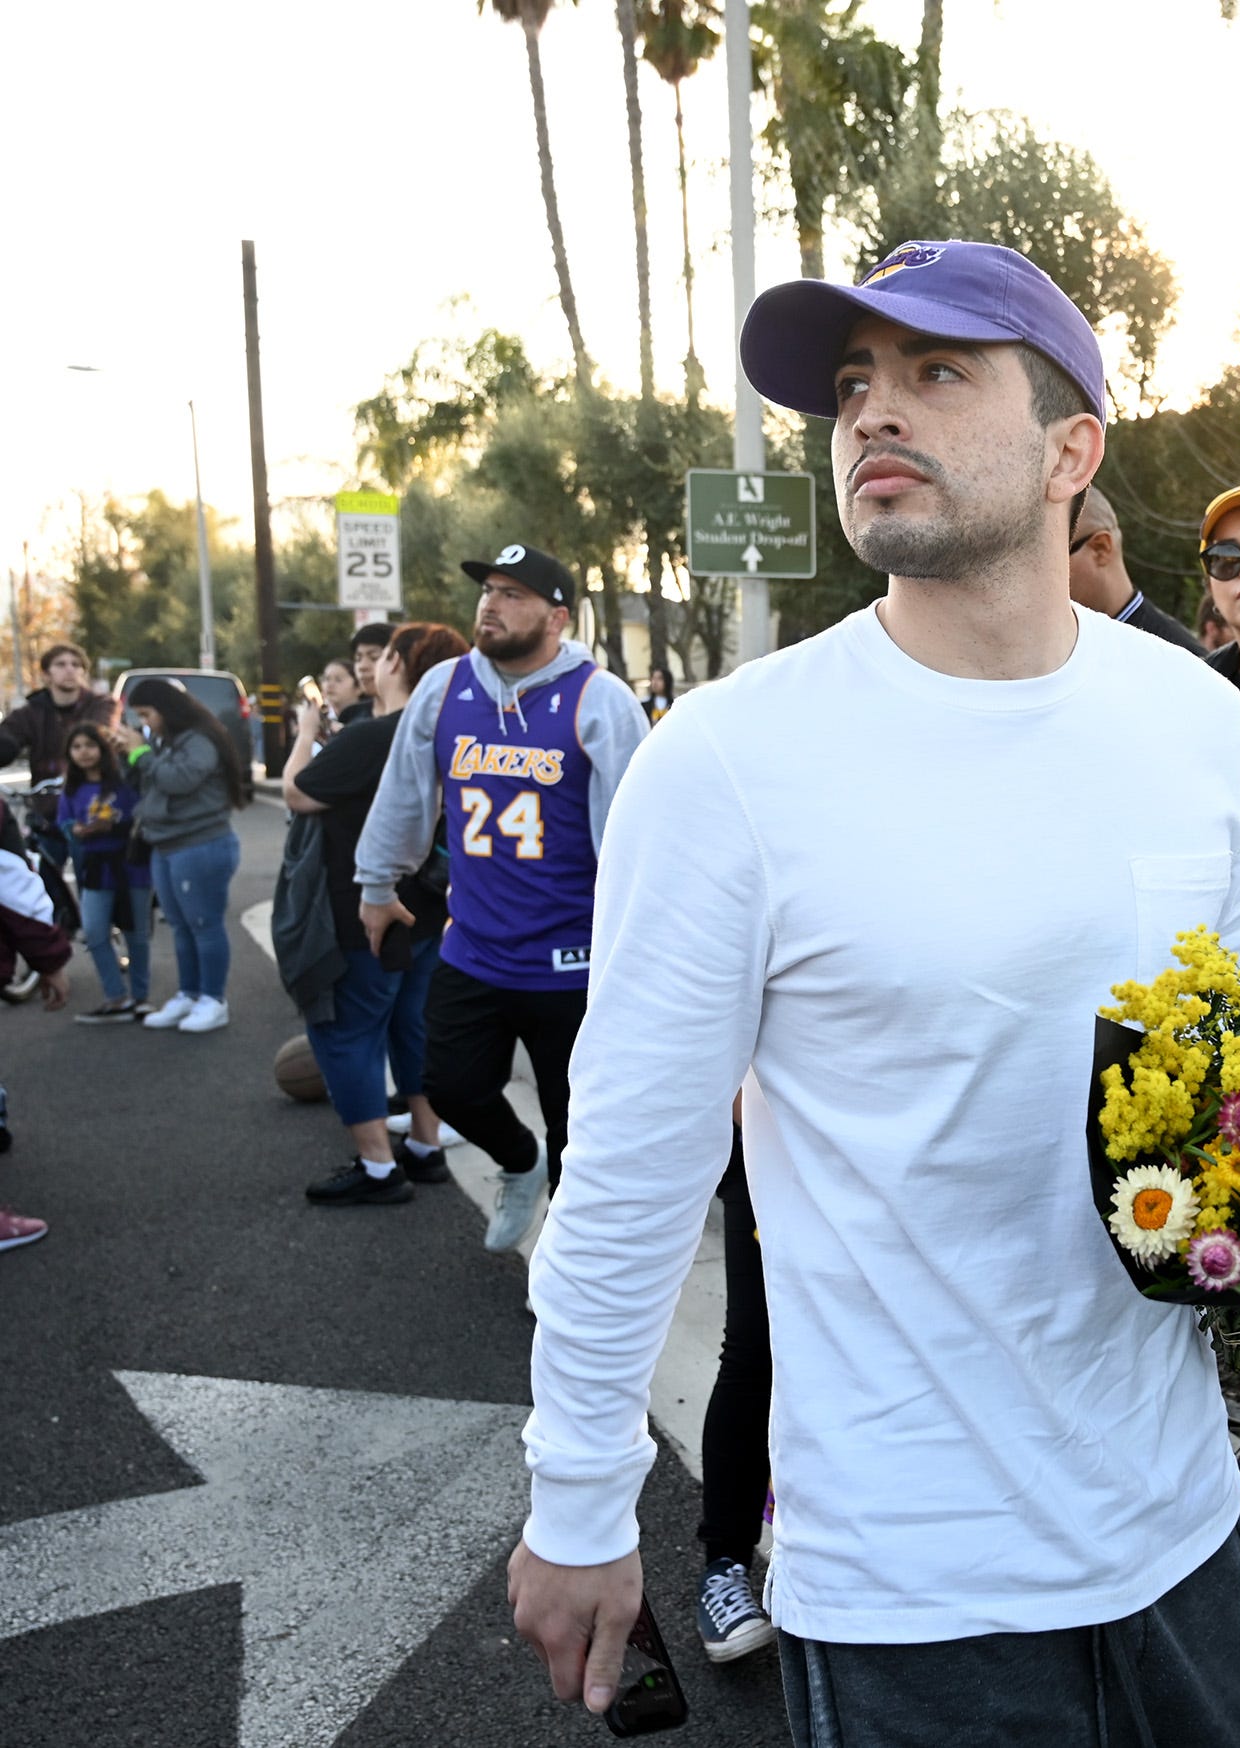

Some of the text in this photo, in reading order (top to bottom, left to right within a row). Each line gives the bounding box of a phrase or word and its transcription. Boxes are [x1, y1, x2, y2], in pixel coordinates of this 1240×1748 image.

[694, 528, 746, 544] Student
[347, 552, 393, 578] 25
[448, 735, 565, 786] LAKERS
[460, 787, 544, 859] 24
